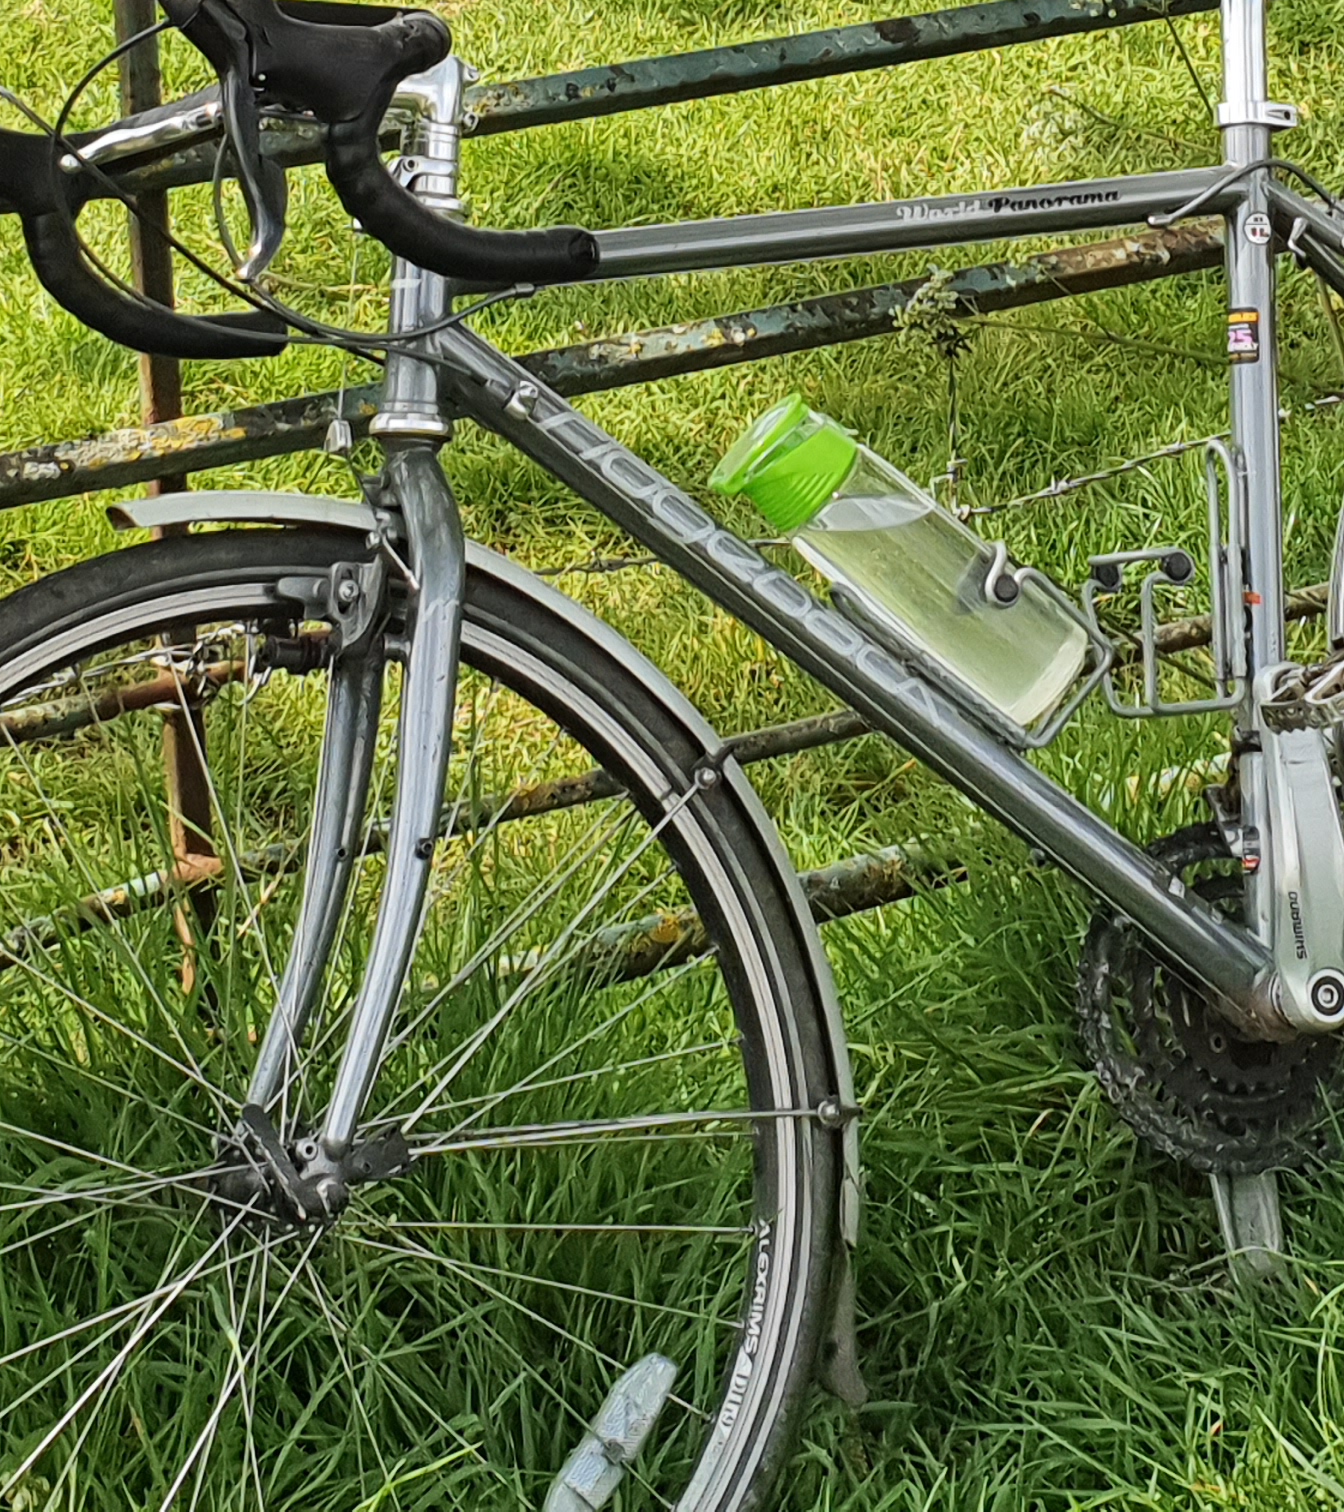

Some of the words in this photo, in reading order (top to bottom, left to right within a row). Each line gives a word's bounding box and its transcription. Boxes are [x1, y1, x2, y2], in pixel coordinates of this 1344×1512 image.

[895, 199, 983, 222] World
[988, 190, 1122, 213] Panorama
[1288, 891, 1307, 960] SHIMANO
[745, 1218, 771, 1355] ALEXRIMS
